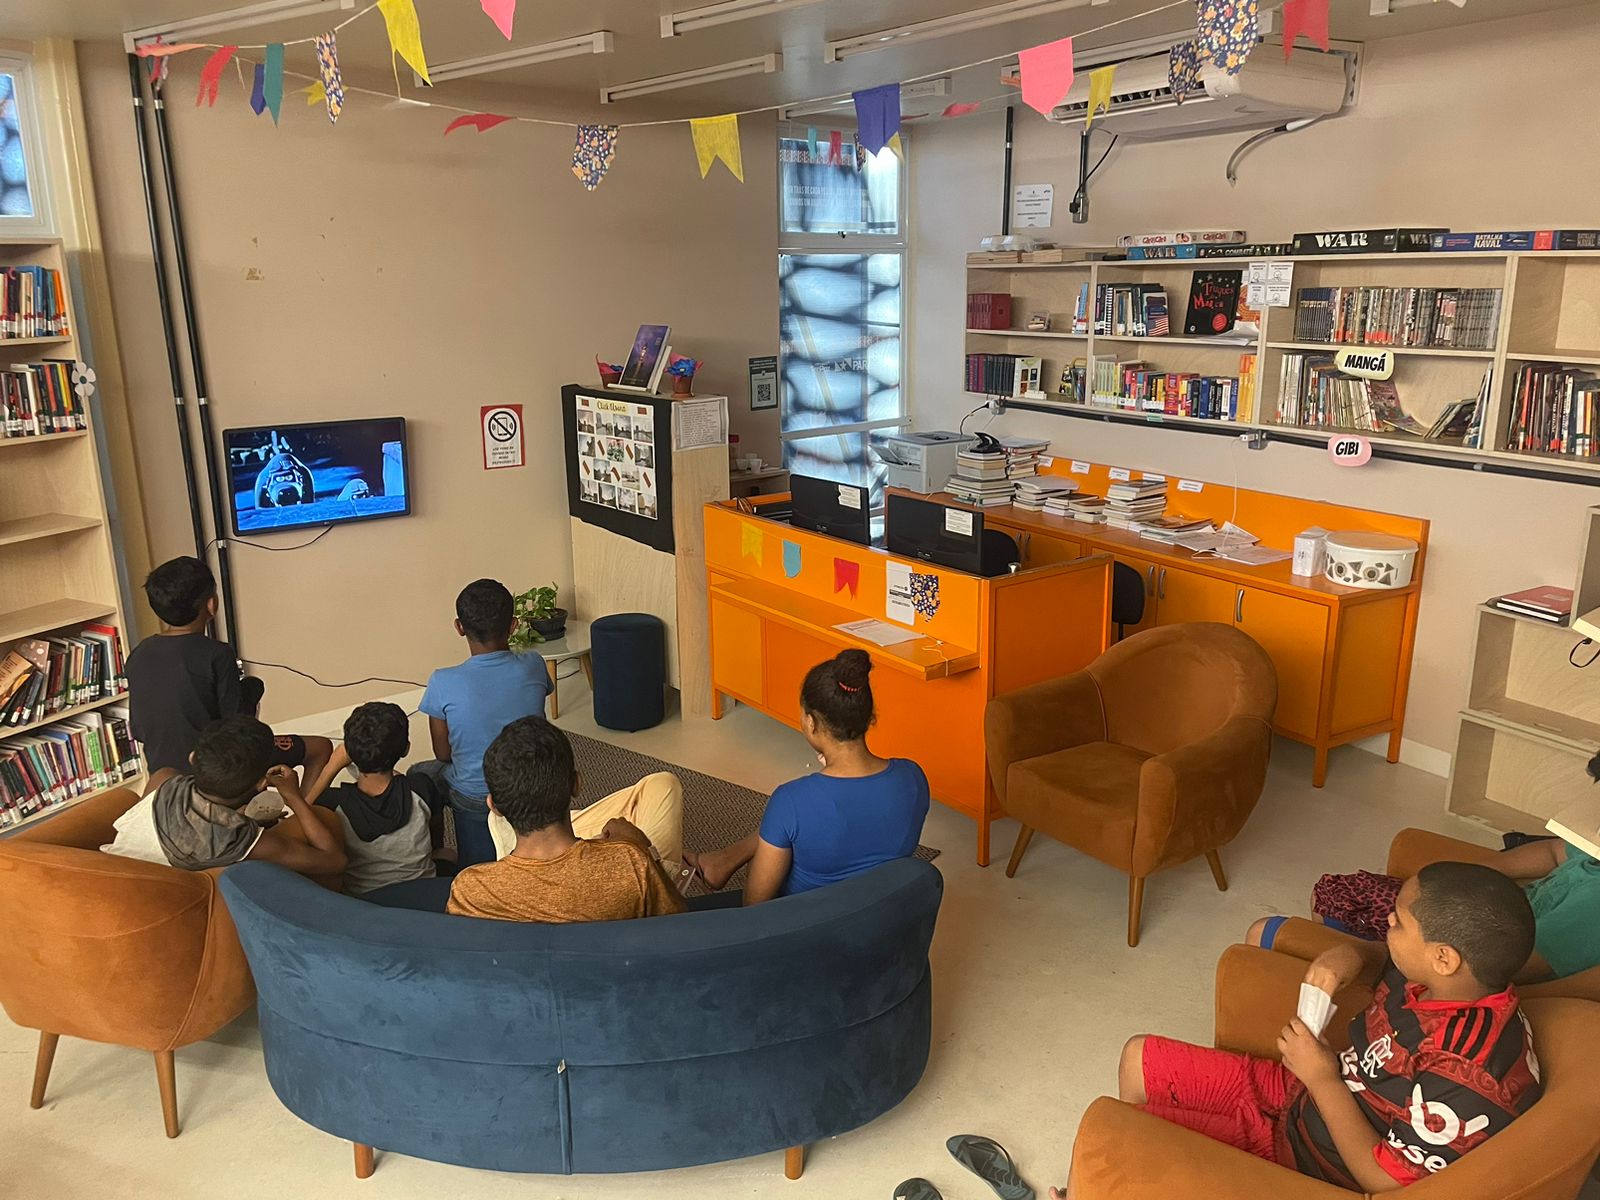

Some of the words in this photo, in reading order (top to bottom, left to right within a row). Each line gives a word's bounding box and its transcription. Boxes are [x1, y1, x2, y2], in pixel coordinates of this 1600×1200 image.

[1315, 232, 1369, 248] WAR
[1474, 239, 1501, 248] NAVAL
[1142, 247, 1177, 258] WAR
[1344, 352, 1387, 372] MANGÁ
[1335, 441, 1360, 456] GIBI
